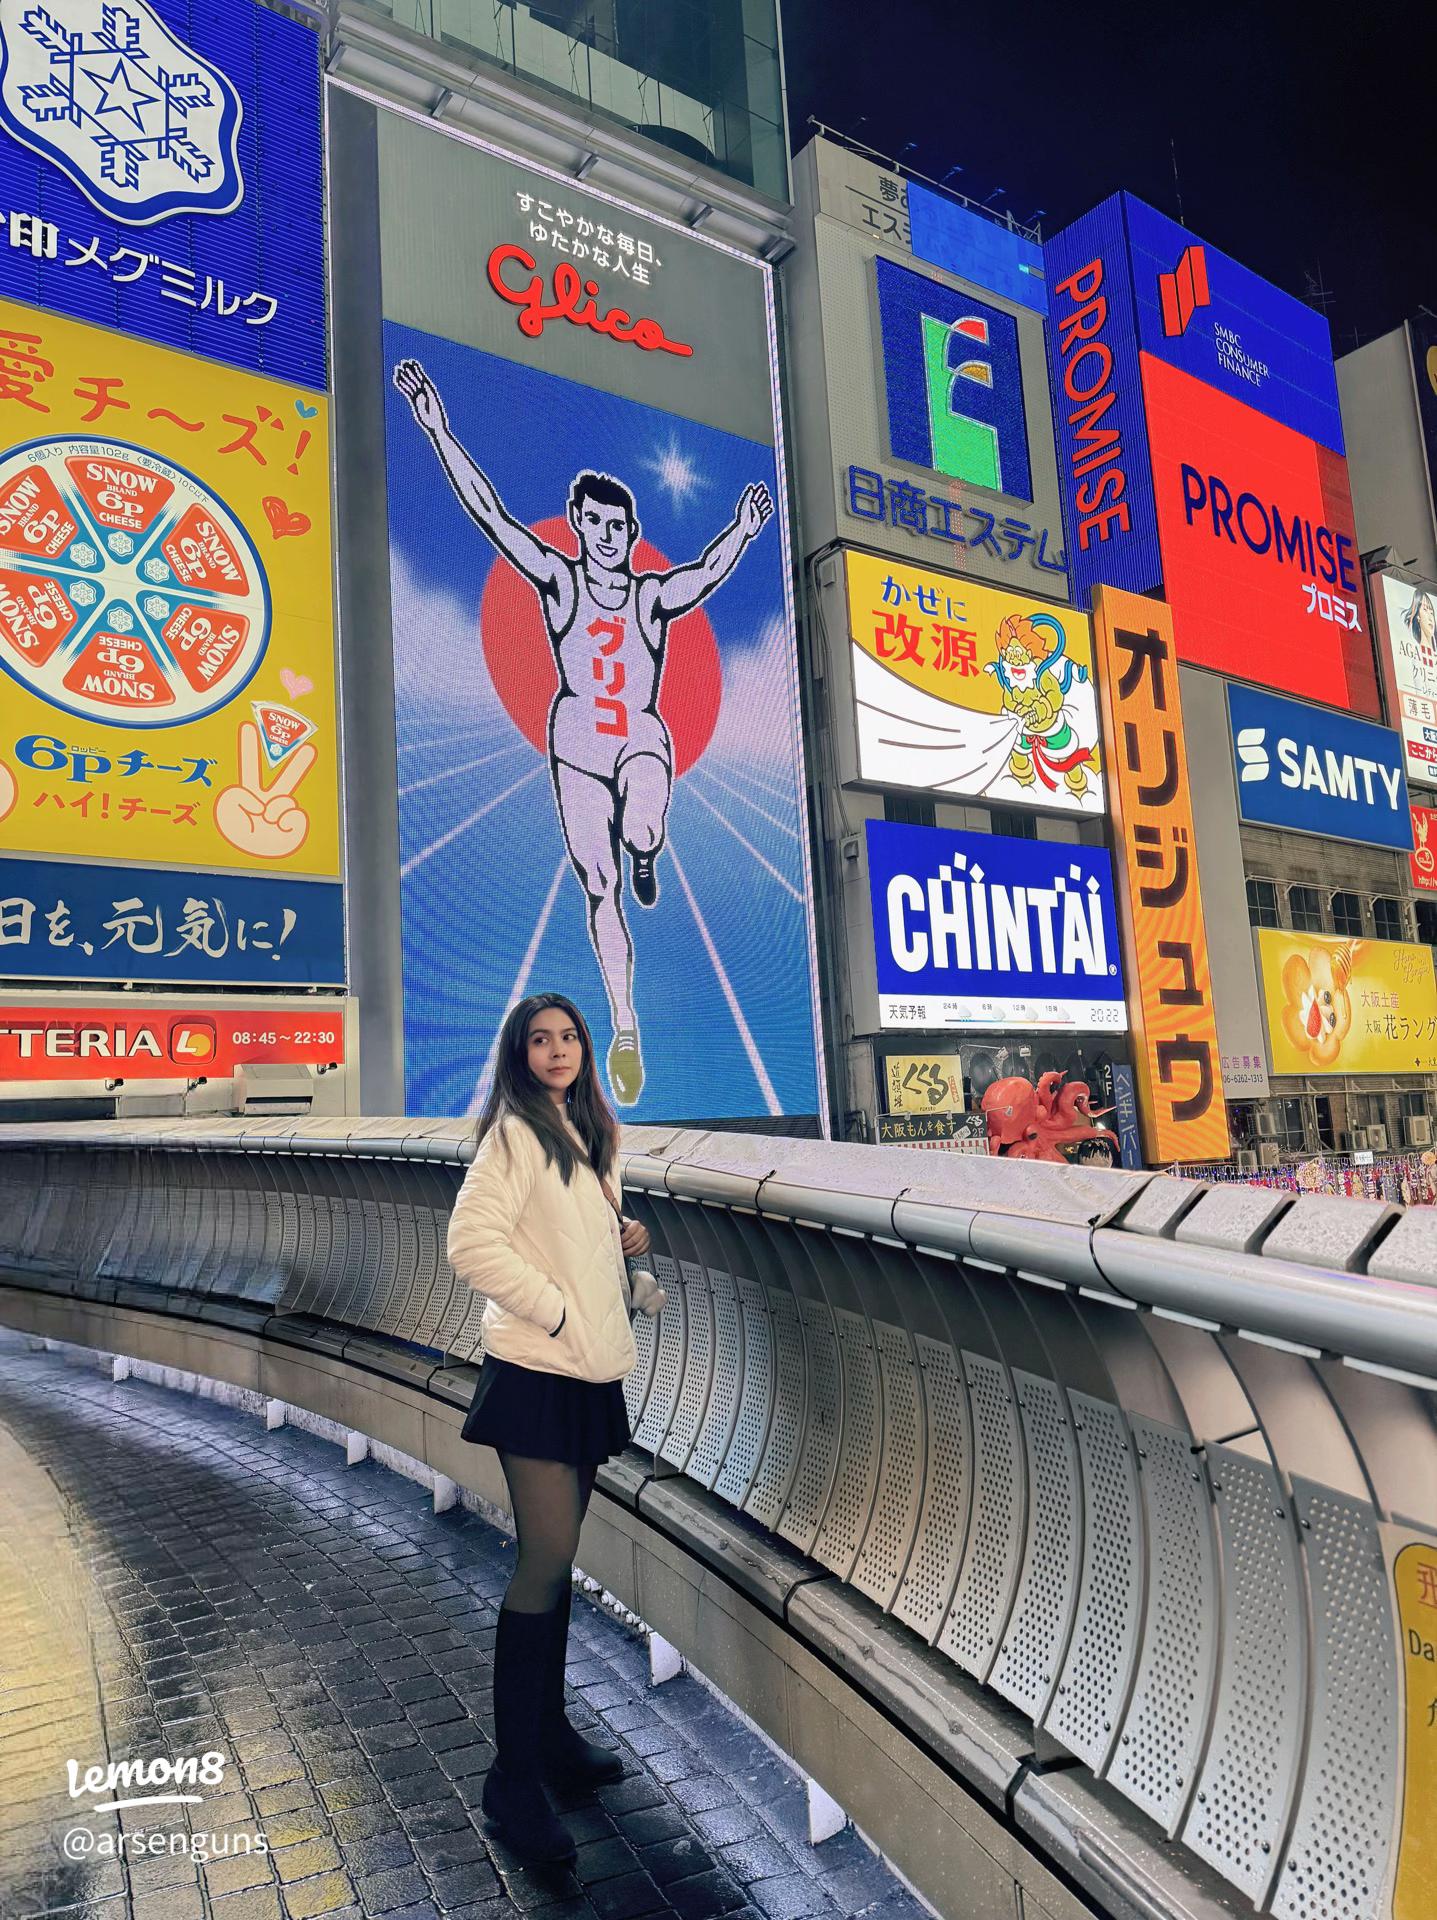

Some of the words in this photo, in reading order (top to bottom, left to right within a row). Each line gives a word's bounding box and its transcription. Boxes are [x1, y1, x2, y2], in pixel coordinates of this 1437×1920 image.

[516, 191, 662, 267] すこやかな毎日、
[0, 211, 279, 326] 印メグミルク
[529, 220, 651, 286] ゆたかな人生
[487, 243, 693, 358] Glico
[1214, 322, 1242, 349] SMBC
[1216, 337, 1271, 379] CONSUMER
[1218, 352, 1261, 387] FINANCE
[1055, 258, 1131, 551] PROMISE
[27, 446, 63, 463] 6個入り
[86, 463, 159, 494] SNOW
[106, 484, 138, 497] BRAND
[0, 476, 41, 535] SNOW
[17, 503, 40, 528] BRAND
[97, 490, 144, 518] 6P
[99, 511, 143, 529] CHEESE
[23, 509, 61, 544] 6P
[45, 521, 75, 555] CHEESE
[1180, 462, 1357, 593] PROMISE
[165, 543, 193, 583] CHEESE
[195, 520, 242, 582] SNOW
[198, 541, 217, 569] BRAND
[16, 595, 37, 625] BRAND
[44, 581, 73, 622] CHEESE
[881, 574, 968, 623] かぜに
[1301, 582, 1363, 633] プロミス
[165, 607, 192, 641] CHEESE
[98, 635, 143, 652] CHEESE
[197, 624, 240, 682] SNOW
[198, 632, 216, 657] BRAND
[871, 609, 980, 680] 改源
[1400, 640, 1421, 662] AGA
[96, 647, 145, 674] 6P
[103, 669, 136, 681] BRAND
[586, 615, 629, 738] グリコ
[81, 674, 156, 701] SNOW
[268, 712, 301, 731] SNOW
[1407, 698, 1431, 720] 薄毛
[1277, 737, 1401, 811] SAMTY
[1114, 627, 1214, 1124] オリジュウ
[886, 852, 1108, 976] CHINTAI
[889, 1004, 926, 1020] 天気予報
[1361, 990, 1399, 1009] 大阪土産
[0, 1028, 163, 1058] TERIA
[1222, 1056, 1262, 1069] 広告募集
[1223, 1074, 1264, 1083] 06-6262-1313
[902, 1062, 949, 1106] くくる
[1104, 1064, 1112, 1096] 2F
[881, 1119, 956, 1139] 大阪もんを食す
[972, 1127, 984, 1137] 2F
[1114, 1073, 1137, 1166] ペンギンバー
